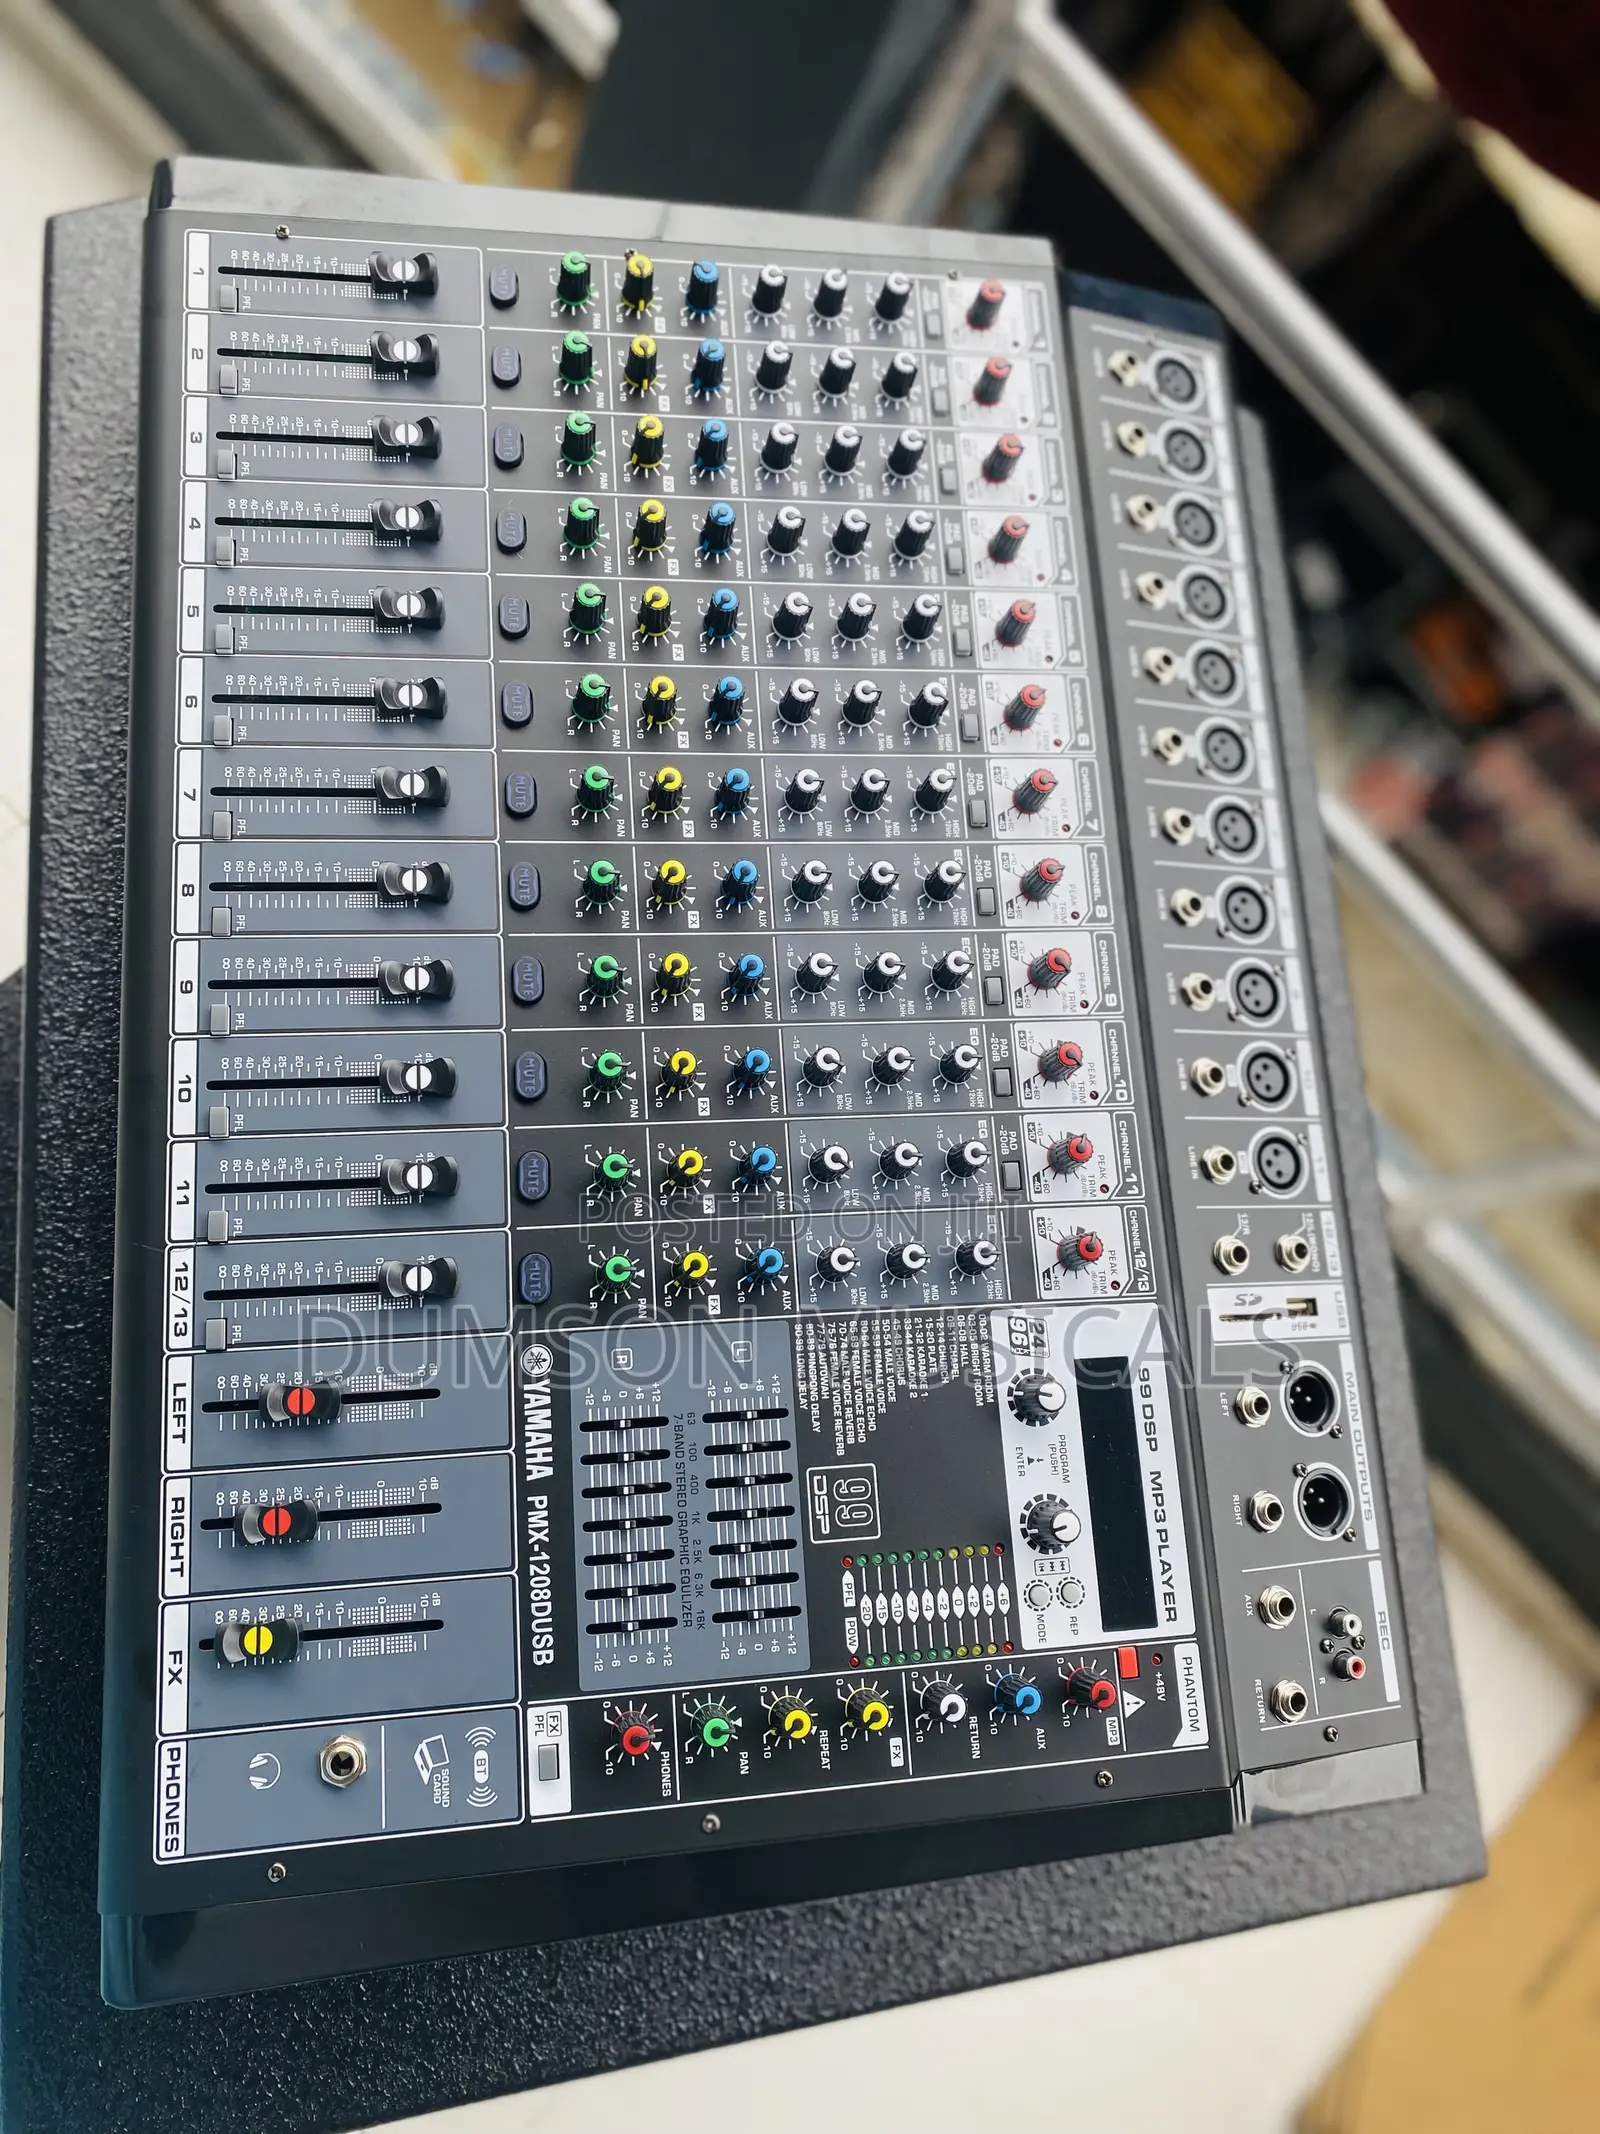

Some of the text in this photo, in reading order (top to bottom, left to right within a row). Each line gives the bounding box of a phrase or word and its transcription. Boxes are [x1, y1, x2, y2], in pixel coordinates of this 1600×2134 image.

[192, 267, 205, 276] 1
[191, 348, 204, 360] 2
[190, 431, 202, 444] 3
[188, 516, 201, 531] 4
[186, 605, 200, 618] 5
[184, 696, 198, 708] 6
[183, 787, 196, 802] 7
[181, 883, 194, 897] 8
[179, 980, 193, 994] 9
[1100, 940, 1117, 1007] CHANNEL 9
[970, 1028, 980, 1046] EQ
[524, 1058, 536, 1094] MUTE
[1109, 1029, 1127, 1102] CHANNEL 10
[178, 1075, 192, 1103] 10
[630, 1098, 640, 1118] PAN
[770, 1094, 779, 1114] AUX
[234, 1114, 244, 1132] PFL
[1000, 1124, 1010, 1156] -20dB
[1009, 1130, 1018, 1150] PAD
[1098, 1154, 1106, 1180] PEAK
[1120, 1120, 1139, 1194] CHANNEL 11
[176, 1180, 190, 1206] 11
[1087, 1174, 1097, 1198] TRIM
[1240, 1212, 1250, 1236] 13/R
[1130, 1210, 1150, 1292] CHANNEL 12/13
[530, 1260, 541, 1298] MUTE
[931, 1284, 939, 1301] MID
[994, 1280, 1002, 1300] HIGH
[172, 1262, 190, 1337] 12/13
[858, 1286, 867, 1306] LOW
[1334, 1291, 1346, 1329] USB
[1010, 1317, 1028, 1346] 96
[1029, 1322, 1046, 1348] 24
[796, 1353, 806, 1379] LONG
[830, 1350, 840, 1388] FEMALE
[840, 1350, 850, 1377] MALE
[852, 1350, 862, 1387] FEMALE
[884, 1348, 894, 1374] MALE
[895, 1347, 906, 1386] CHORUS
[906, 1347, 917, 1390] KARAOKE
[916, 1346, 928, 1390] KARAOKE
[928, 1345, 938, 1374] PLATE
[938, 1345, 950, 1384] CHURCH
[949, 1344, 960, 1380] CHAPEL
[960, 1344, 970, 1368] HALL
[970, 1343, 981, 1376] BRIGHT
[982, 1342, 992, 1375] WARM
[708, 1380, 716, 1398] -12
[740, 1382, 748, 1390] 0
[755, 1378, 764, 1392] +6
[772, 1374, 780, 1394] +12
[808, 1352, 818, 1402] PINGPONG
[886, 1375, 896, 1403] VOICE
[984, 1375, 995, 1403] ROOM
[798, 1380, 808, 1410] DELAY
[832, 1389, 842, 1417] VOICE
[843, 1378, 852, 1406] VOICE
[854, 1388, 864, 1416] VOICE
[974, 1378, 984, 1407] ROOM
[1220, 1392, 1230, 1417] LEFT
[172, 1382, 188, 1444] LEFT
[810, 1404, 821, 1433] DELAY
[845, 1407, 855, 1444] REVERB
[834, 1418, 844, 1456] REVERB
[856, 1417, 866, 1443] ECHO
[1048, 1444, 1059, 1476] (PUSH)
[1058, 1434, 1070, 1484] PROGRAM
[1345, 1372, 1373, 1521] MAIN OUTPUTS
[1016, 1446, 1026, 1477] ENTER
[814, 1475, 831, 1534] DSP
[832, 1477, 874, 1528] 99
[1138, 1368, 1178, 1622] 99 DSP MP3 PLAYER
[524, 1380, 554, 1666] YAMAHA PMX-1208DUSB
[672, 1414, 692, 1629] 7-BAND STEREO GRAPHIC EQULIZER
[688, 1413, 705, 1630] 63 100 400 1K 2.5K 6.3K 16K
[1232, 1494, 1243, 1526] RIGHT
[168, 1496, 186, 1577] RIGHT
[844, 1582, 853, 1606] PFL
[954, 1598, 962, 1607] 0
[1000, 1590, 1008, 1606] +6
[1244, 1594, 1254, 1616] AUX
[863, 1602, 871, 1622] -20
[894, 1601, 902, 1620] -10
[847, 1620, 856, 1646] POW
[1036, 1614, 1046, 1644] MODE
[1070, 1616, 1078, 1636] REP
[1377, 1610, 1390, 1651] REC
[166, 1650, 183, 1685] FX
[1154, 1671, 1166, 1702] +48V
[1182, 1656, 1200, 1732] PHANTOM
[1254, 1678, 1266, 1724] RETURN
[534, 1715, 544, 1736] PFL
[550, 1716, 558, 1734] FX
[968, 1716, 980, 1759] RETURN
[1036, 1728, 1046, 1750] AUX
[1109, 1720, 1118, 1744] MP3
[739, 1752, 749, 1774] PAN
[818, 1730, 830, 1770] REPEAT
[892, 1744, 901, 1760] FX
[476, 1757, 488, 1778] BT
[660, 1751, 672, 1797] PHONES
[164, 1746, 182, 1854] PHONES
[433, 1773, 442, 1804] CARD
[440, 1768, 450, 1808] SOUND
